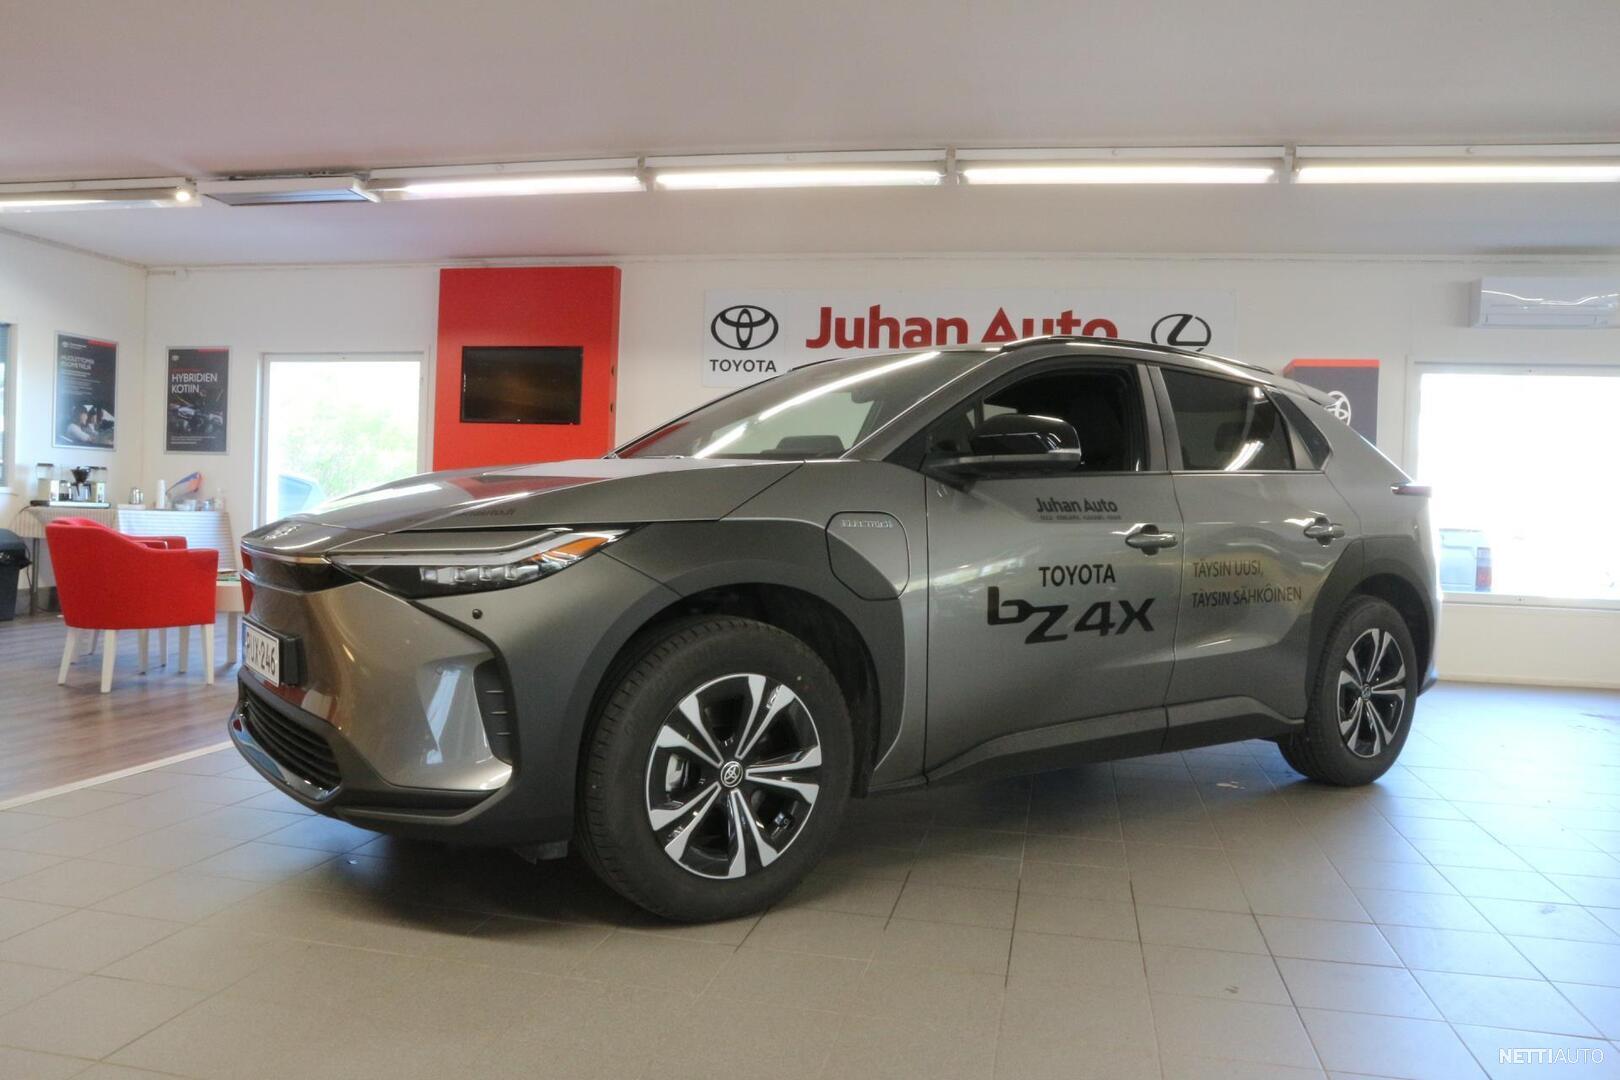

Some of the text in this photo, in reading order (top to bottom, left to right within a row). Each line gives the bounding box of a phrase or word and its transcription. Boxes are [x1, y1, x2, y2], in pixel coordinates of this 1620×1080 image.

[805, 304, 1118, 350] Juhan Auto
[709, 358, 777, 373] TOYOTA
[171, 372, 218, 383] HYBRIDIEN
[171, 384, 200, 394] KOTIIN
[1036, 498, 1118, 514] Juhan Auto
[1038, 564, 1116, 587] TOYOTA
[1193, 559, 1264, 579] TÄYSIN UUSI,
[1191, 586, 1302, 609] TÄYSIN SÄHKÖINEN
